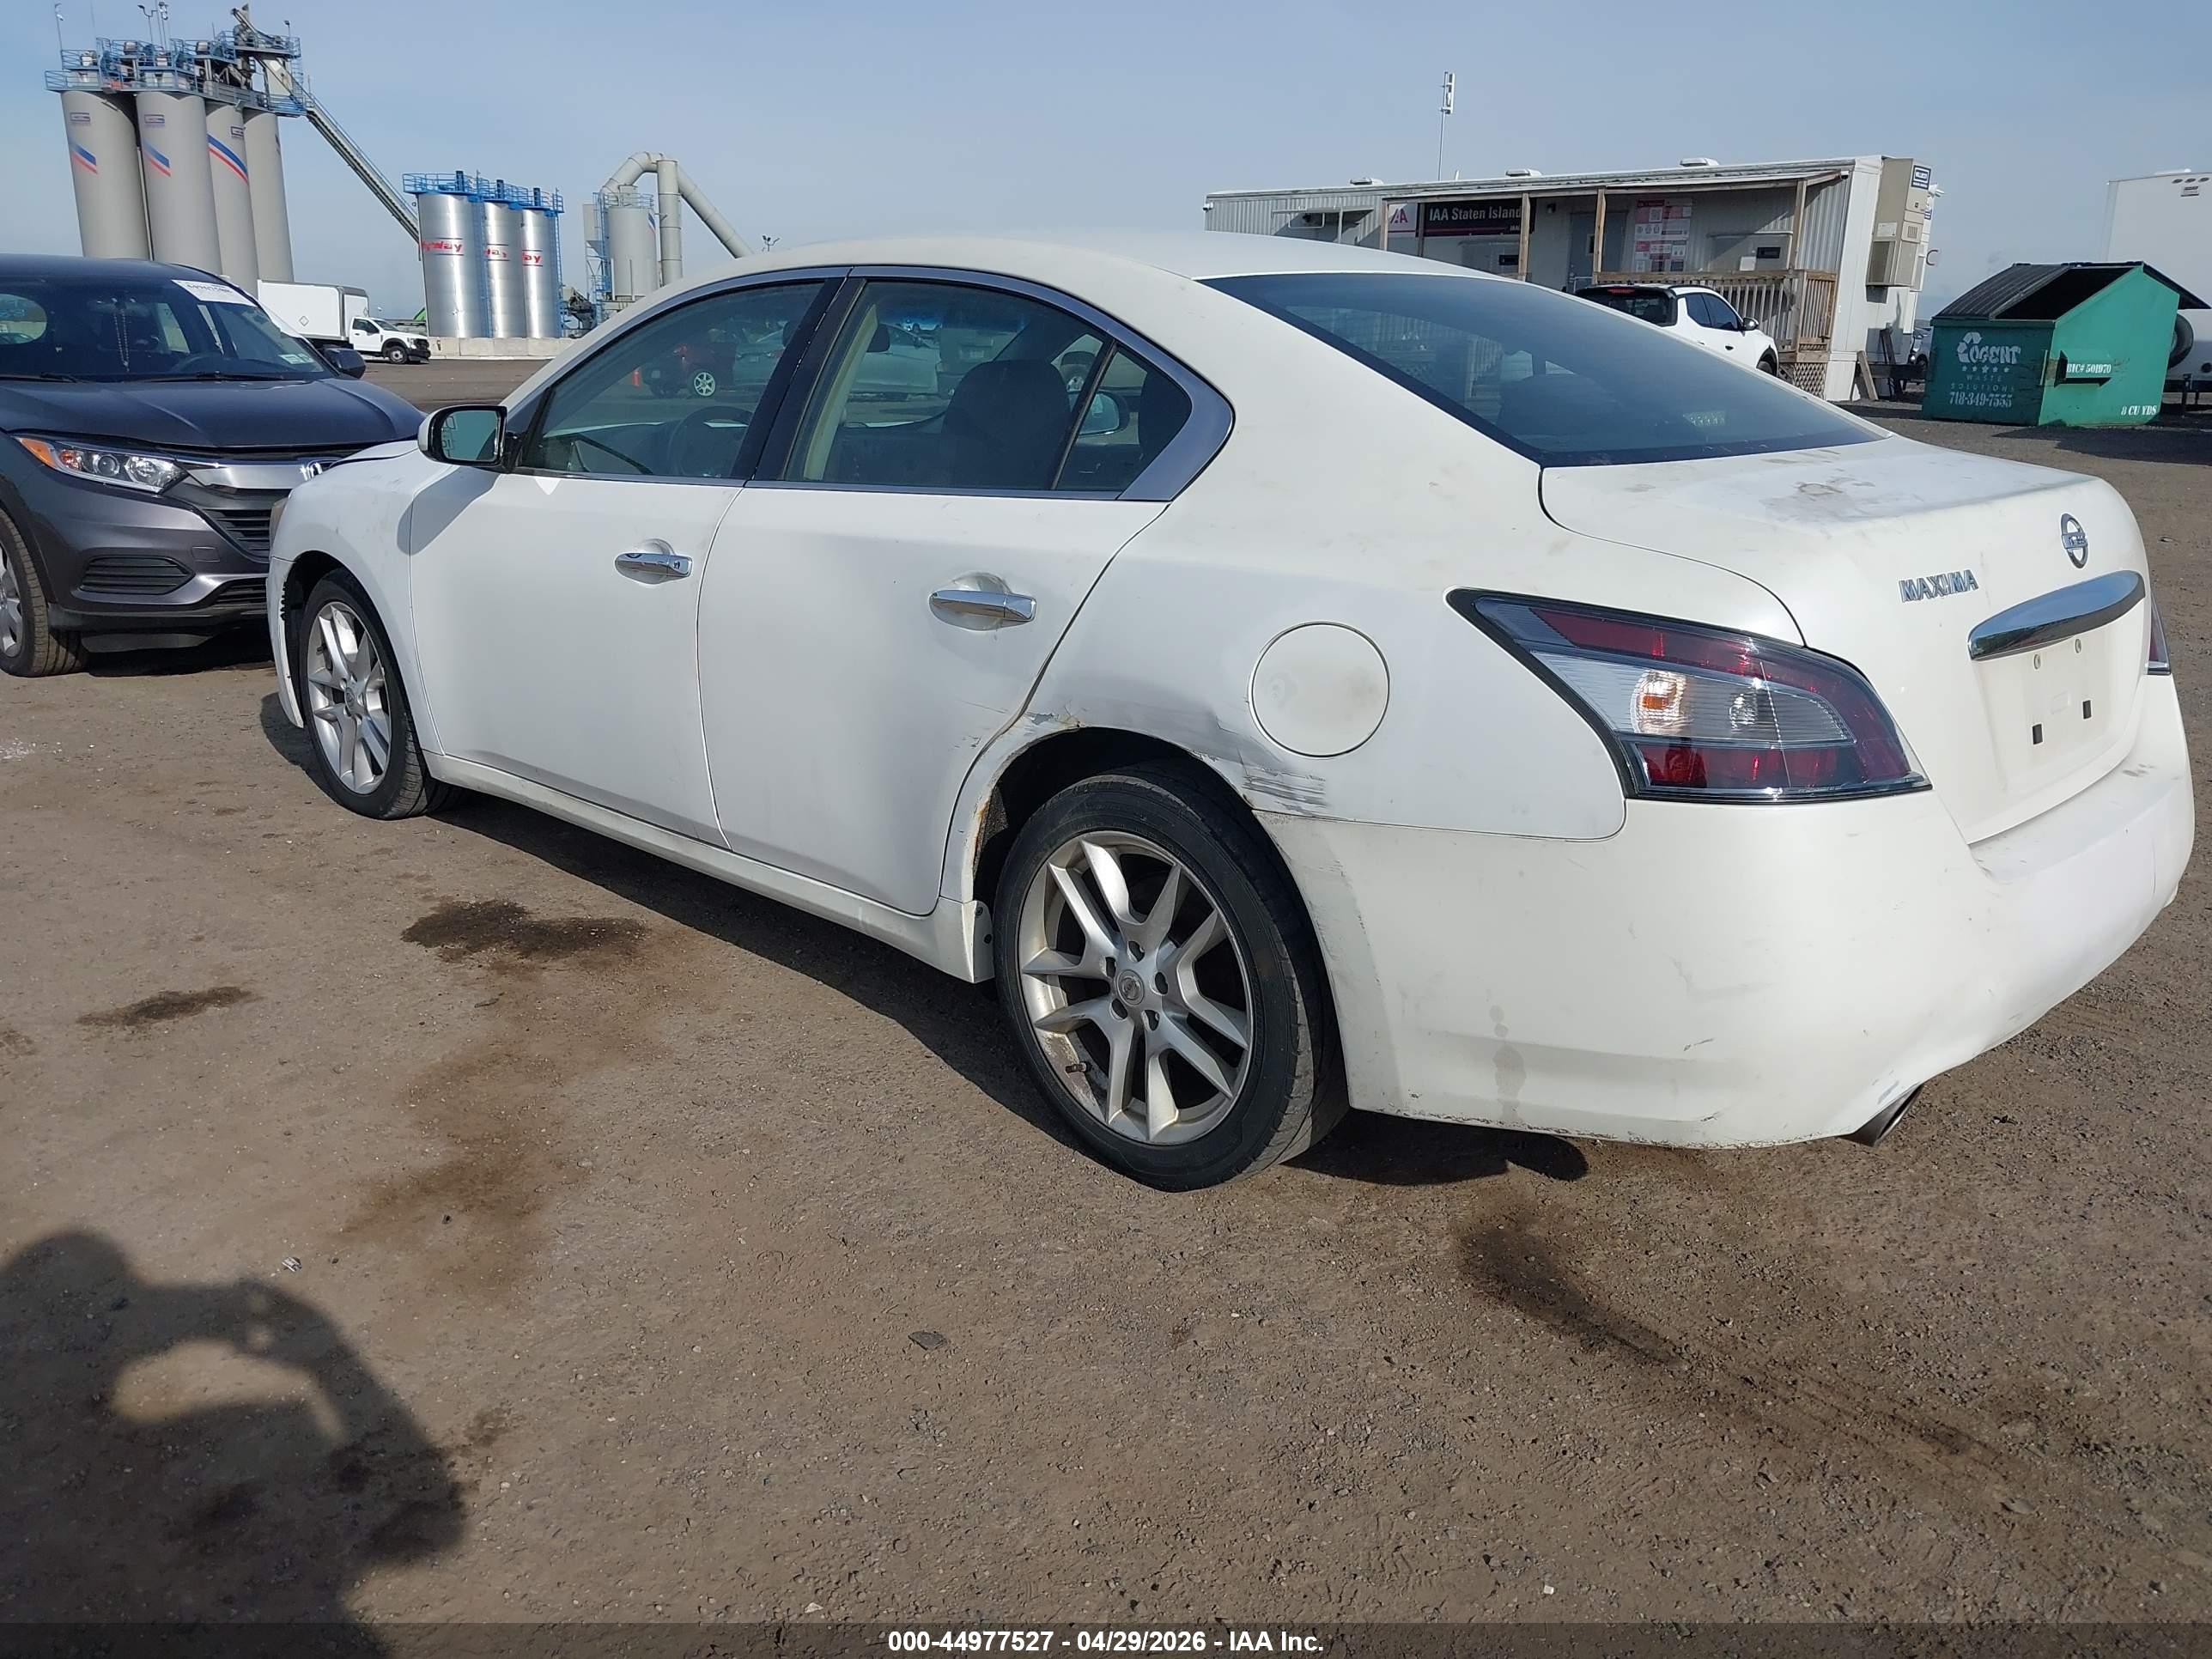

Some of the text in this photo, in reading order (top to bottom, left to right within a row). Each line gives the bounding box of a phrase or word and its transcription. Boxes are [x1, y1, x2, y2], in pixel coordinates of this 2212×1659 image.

[1429, 208, 1449, 221] IAA
[1451, 207, 1486, 221] Staten
[1949, 391, 2013, 408] 718-349-7555
[2129, 405, 2140, 416] CU
[2142, 405, 2158, 416] YDS
[1899, 569, 1978, 603] MAXIMA
